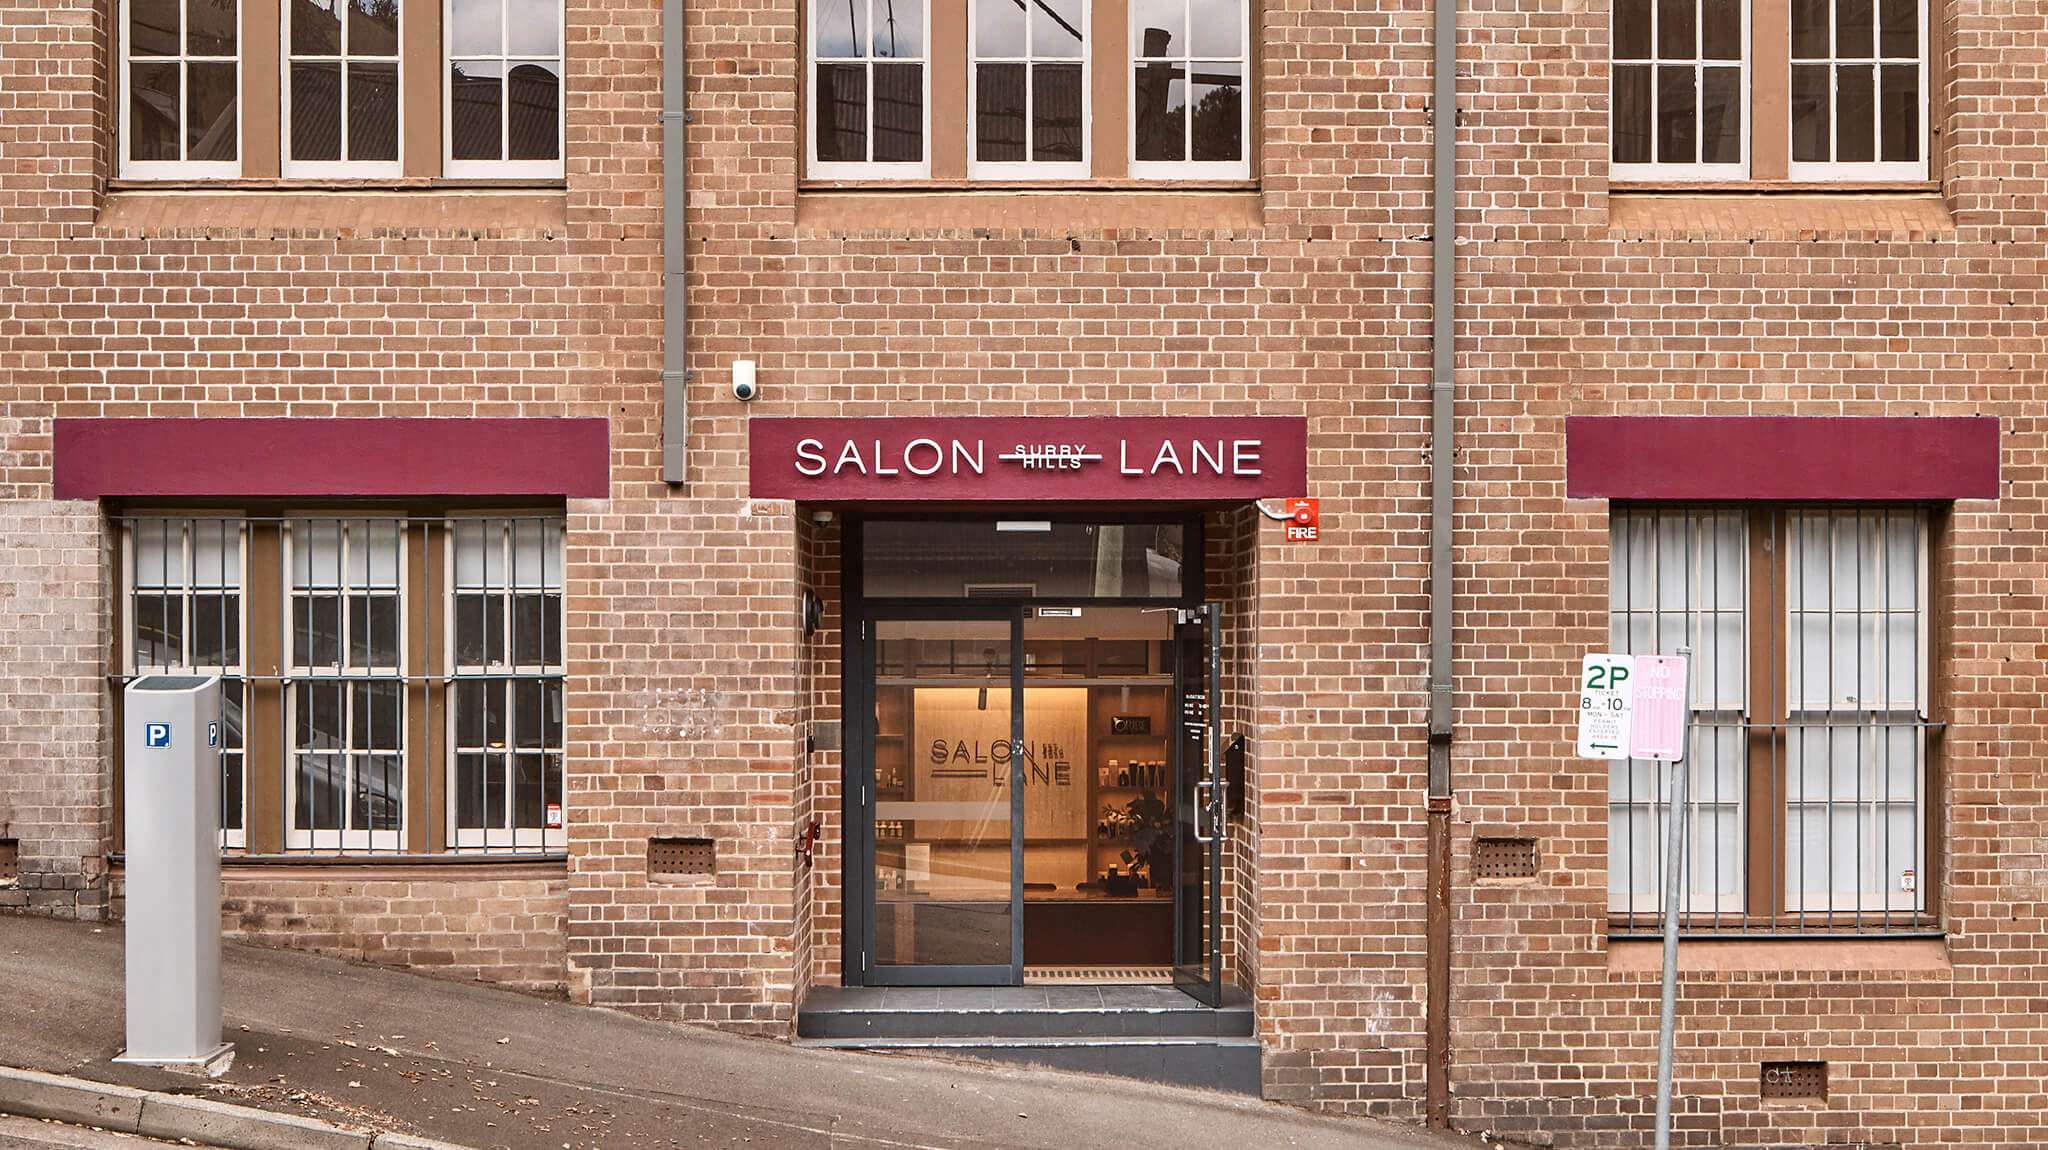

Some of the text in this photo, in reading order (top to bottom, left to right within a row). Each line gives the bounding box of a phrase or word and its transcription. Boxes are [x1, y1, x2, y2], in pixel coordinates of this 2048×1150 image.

[794, 438, 985, 476] SALON
[1023, 456, 1082, 469] HILLS
[1119, 439, 1262, 475] LANE
[1288, 527, 1317, 539] FIRE
[1587, 666, 1629, 689] 2P
[1651, 666, 1670, 679] NO
[1595, 689, 1620, 697] TICKET
[1636, 688, 1683, 700] STOPPING
[150, 725, 166, 745] P
[931, 739, 1035, 764] SALON
[992, 761, 1071, 787] LNE
